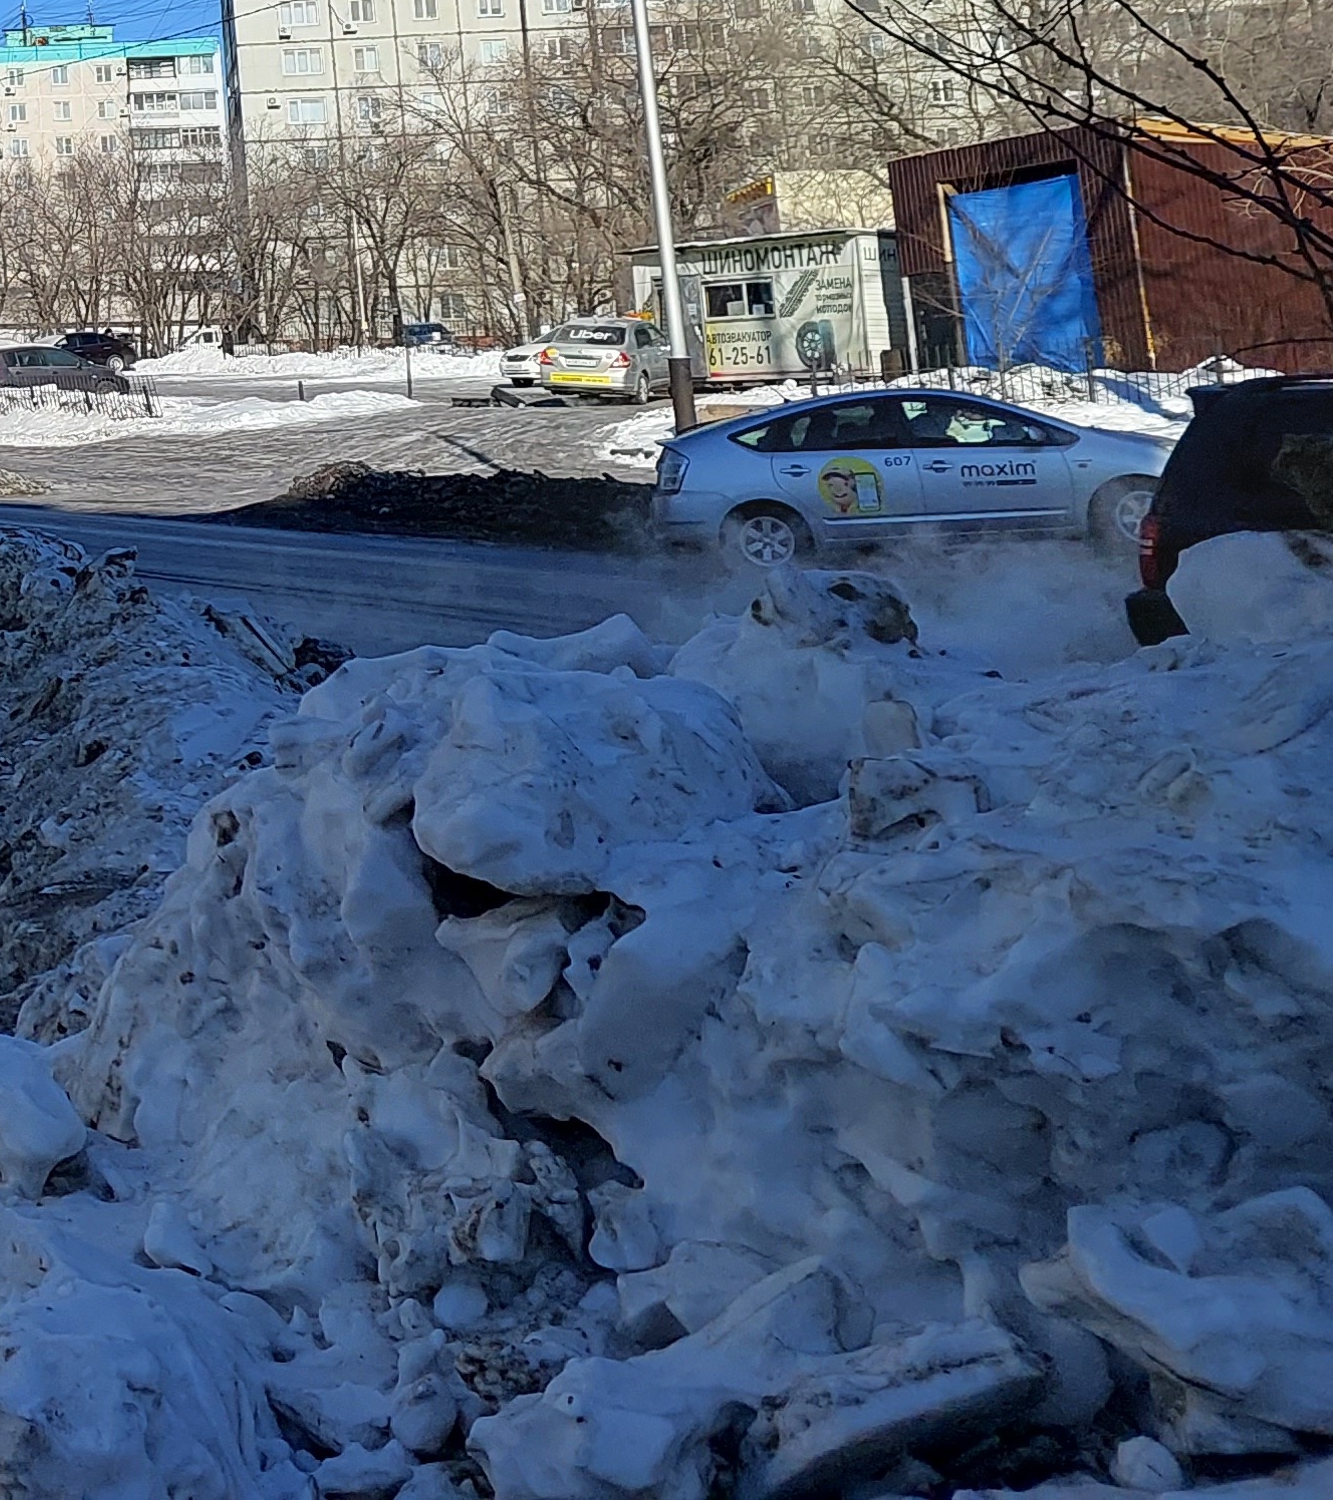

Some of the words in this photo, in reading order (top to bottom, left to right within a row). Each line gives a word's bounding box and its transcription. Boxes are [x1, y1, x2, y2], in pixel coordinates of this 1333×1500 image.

[701, 240, 840, 275] ШИНОМОНТАЖ
[815, 276, 853, 291] ЗАМЕНА
[569, 329, 613, 341] Uber
[709, 345, 773, 367] 61-25-61
[884, 455, 911, 467] 607
[961, 459, 1036, 478] maxim
